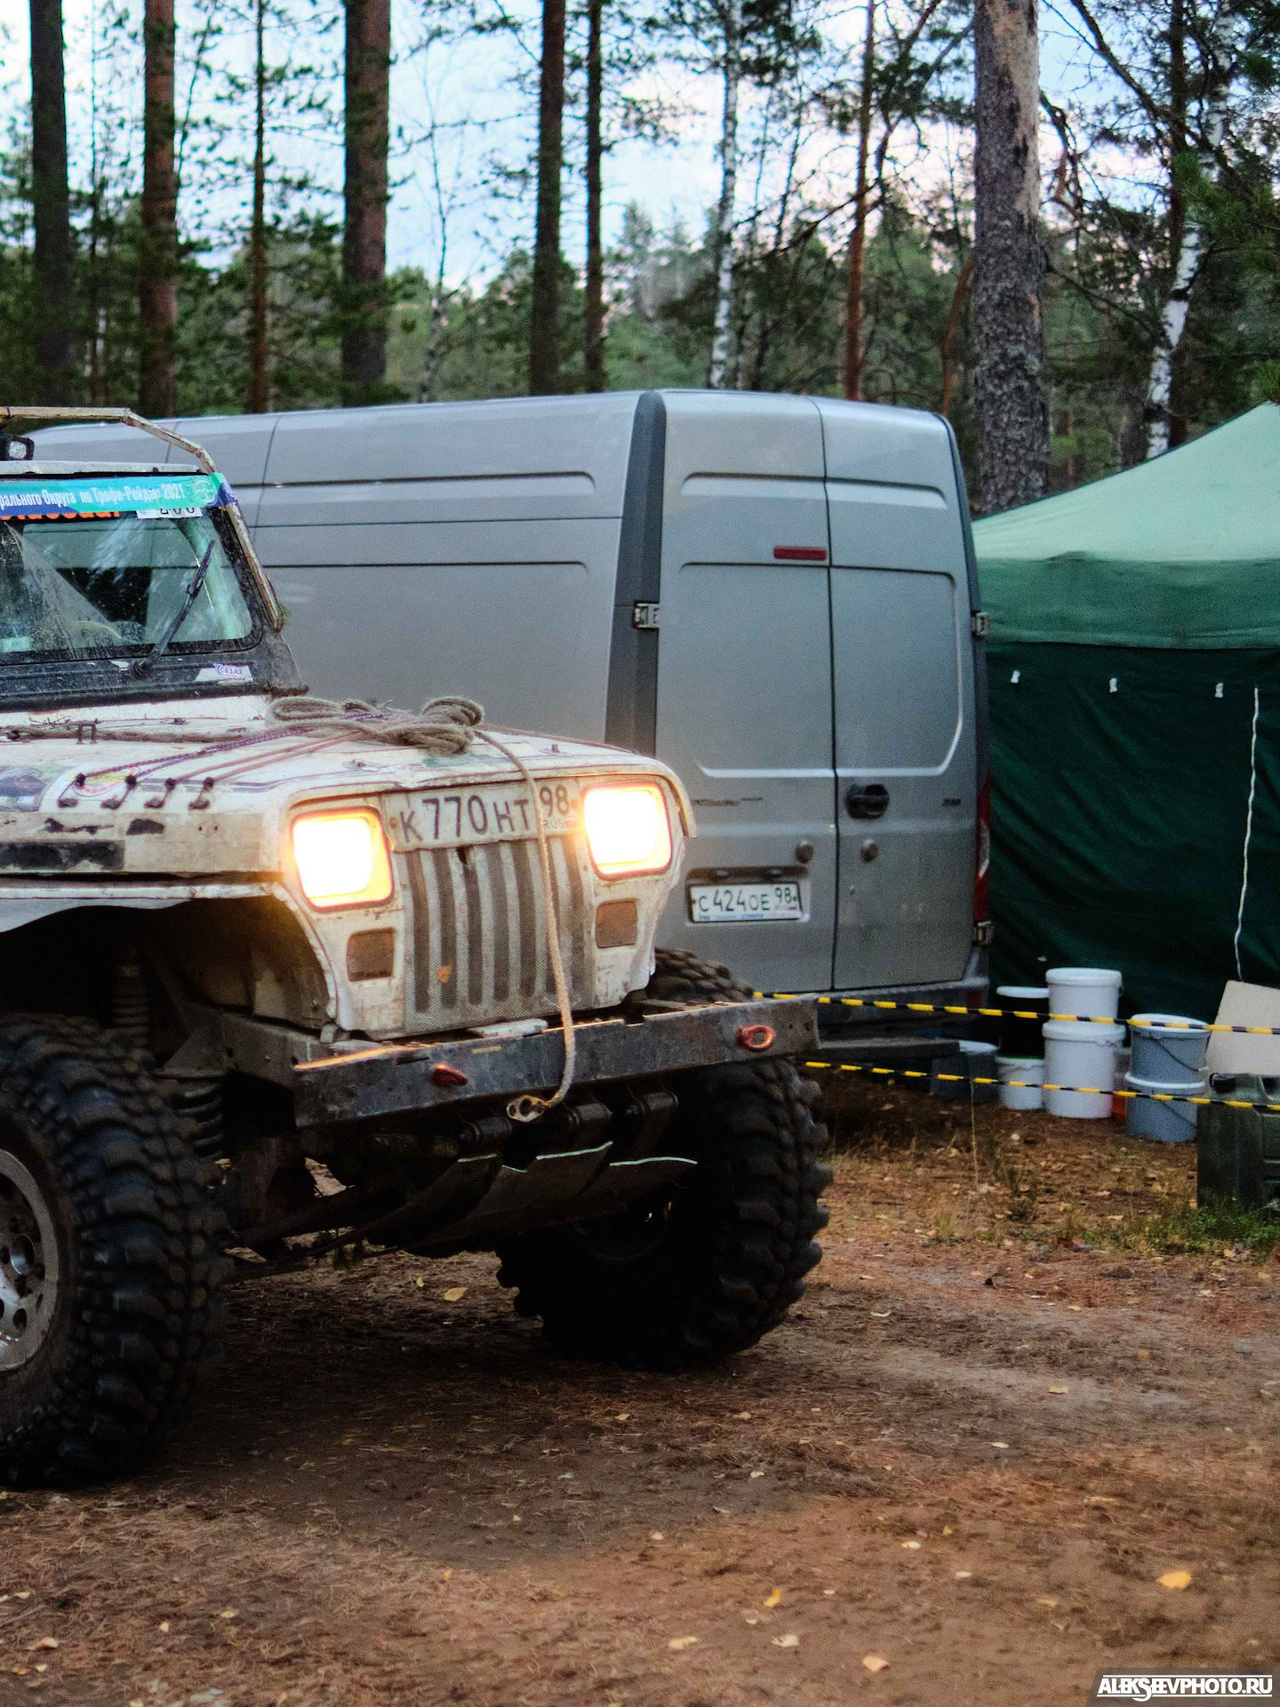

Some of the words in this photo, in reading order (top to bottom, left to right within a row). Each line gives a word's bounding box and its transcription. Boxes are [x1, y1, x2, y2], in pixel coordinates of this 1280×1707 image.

[42, 489, 76, 508] Округа
[81, 491, 92, 503] по
[163, 483, 185, 500] 2021
[539, 784, 572, 818] 98
[543, 817, 565, 830] RUS
[774, 886, 792, 904] 98
